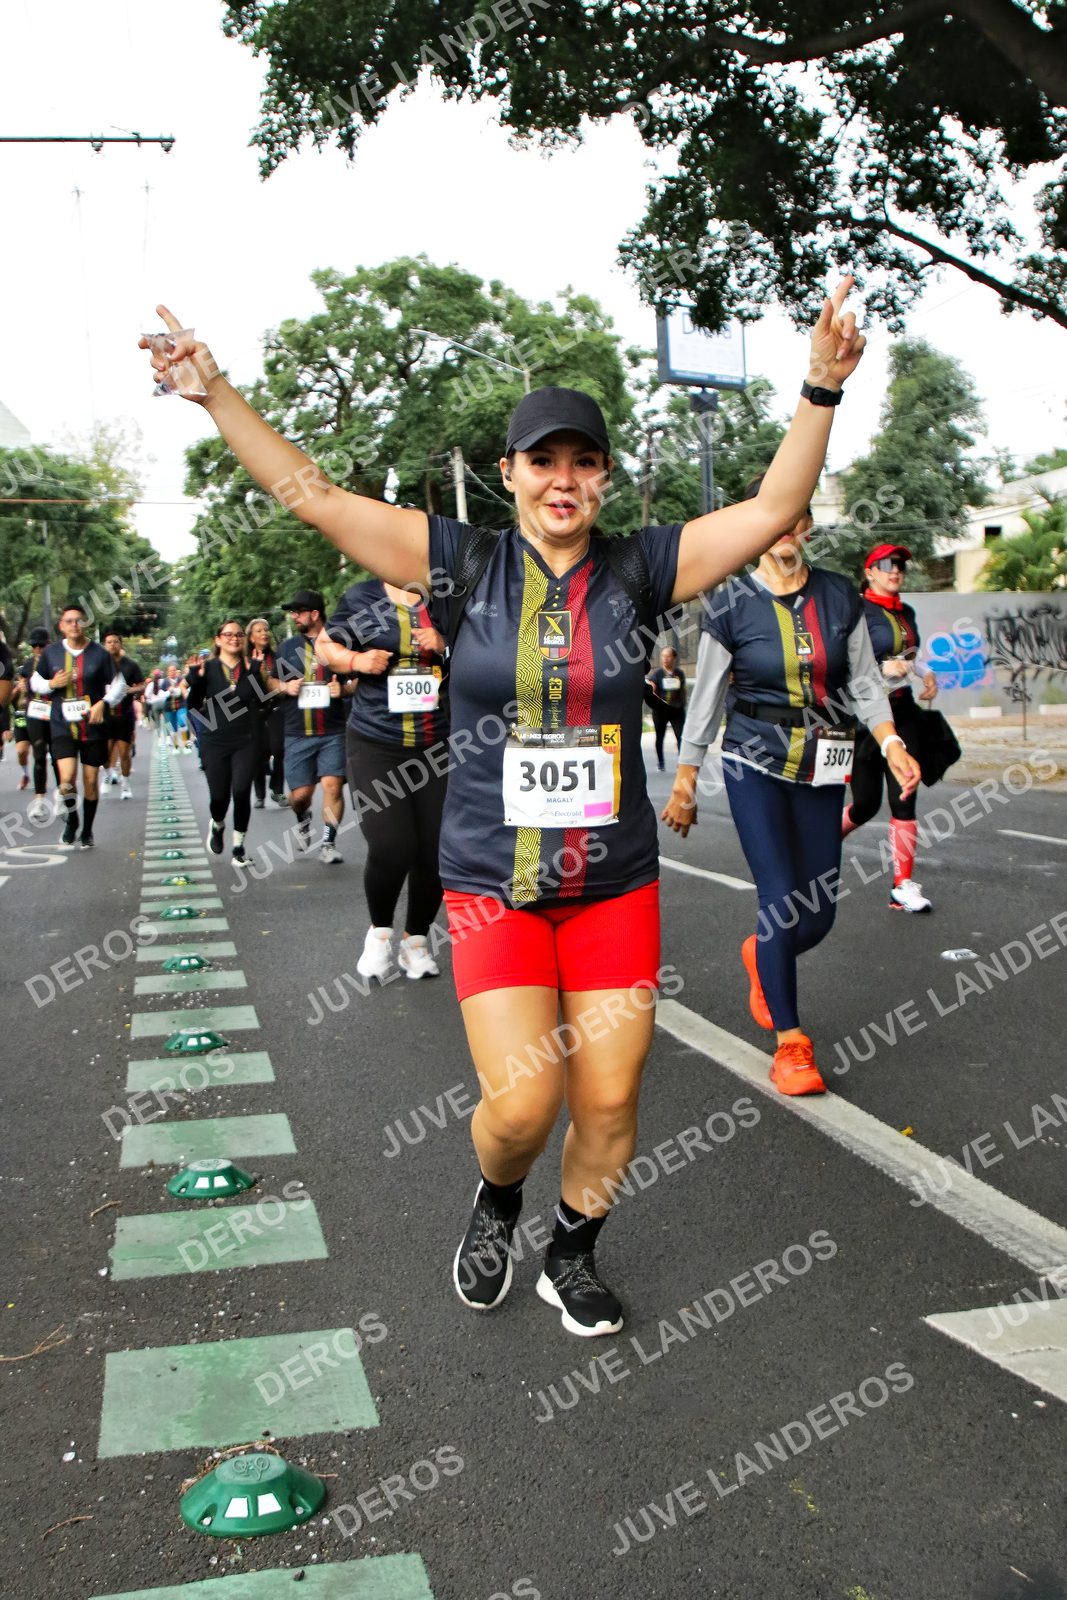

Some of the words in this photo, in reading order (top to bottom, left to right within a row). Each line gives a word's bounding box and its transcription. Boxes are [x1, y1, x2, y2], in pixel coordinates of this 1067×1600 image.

[397, 681, 431, 695] 5800
[603, 733, 616, 744] 5K
[823, 748, 853, 766] 3307
[520, 760, 596, 792] 3051
